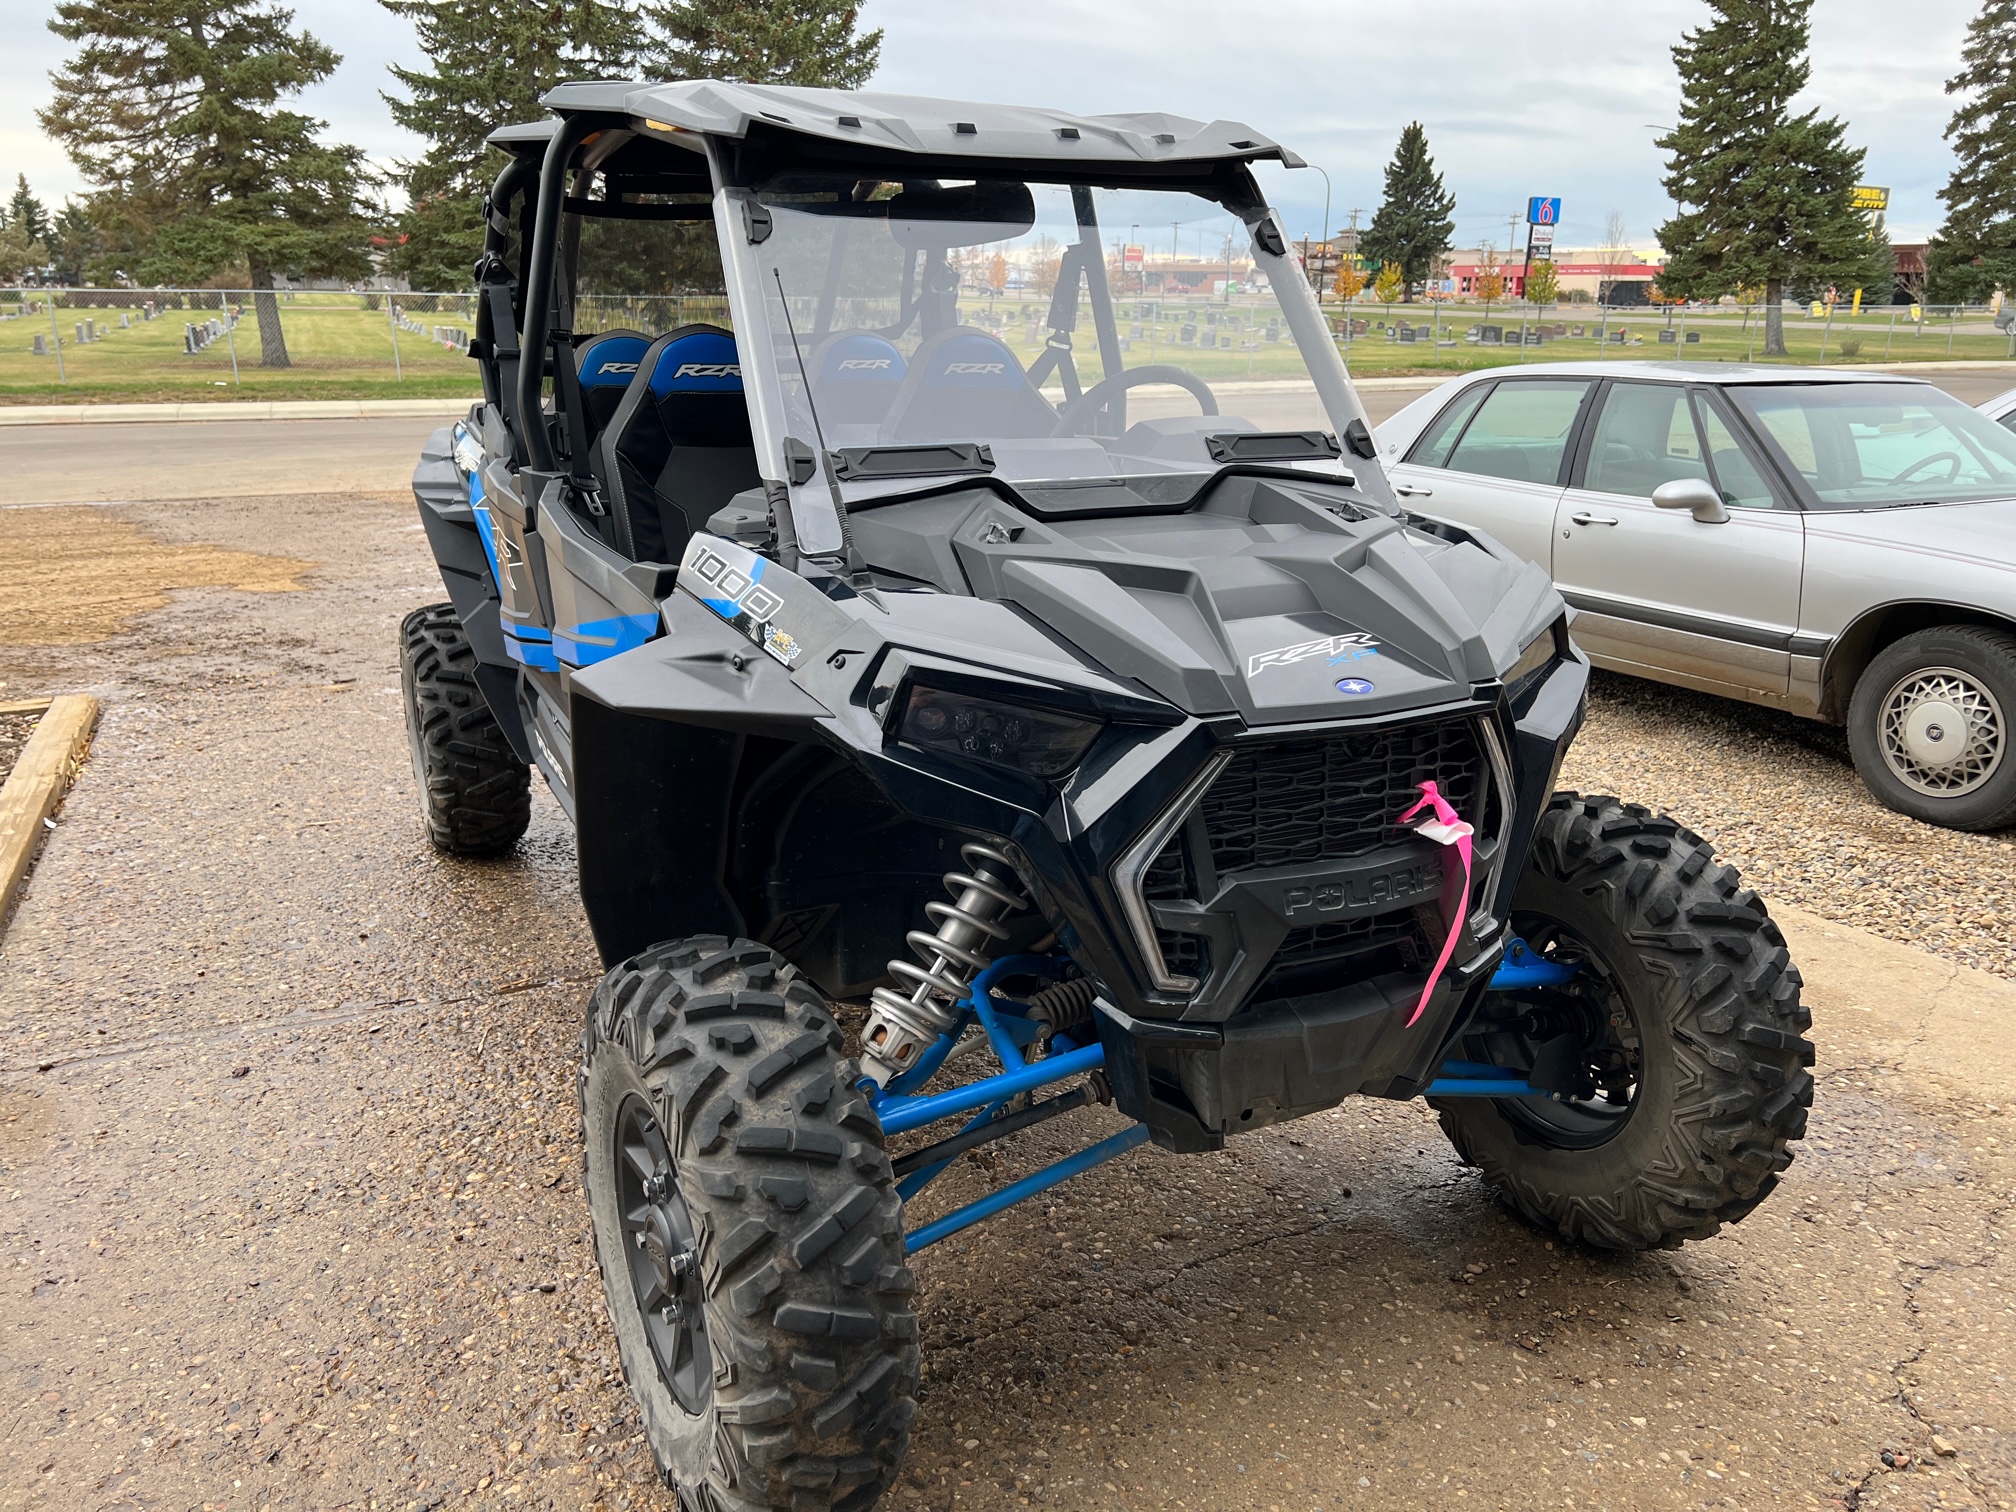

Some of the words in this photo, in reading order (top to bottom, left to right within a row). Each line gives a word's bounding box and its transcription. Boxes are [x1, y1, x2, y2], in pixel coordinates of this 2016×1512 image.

[1539, 198, 1554, 224] 6
[597, 362, 640, 375] RZ
[673, 363, 742, 379] RZR
[837, 359, 892, 371] RZR
[943, 363, 1005, 376] RZR
[688, 545, 785, 623] 1000
[1248, 632, 1381, 679] RZR
[1324, 647, 1378, 667] XP
[1283, 850, 1443, 916] POLARIS
